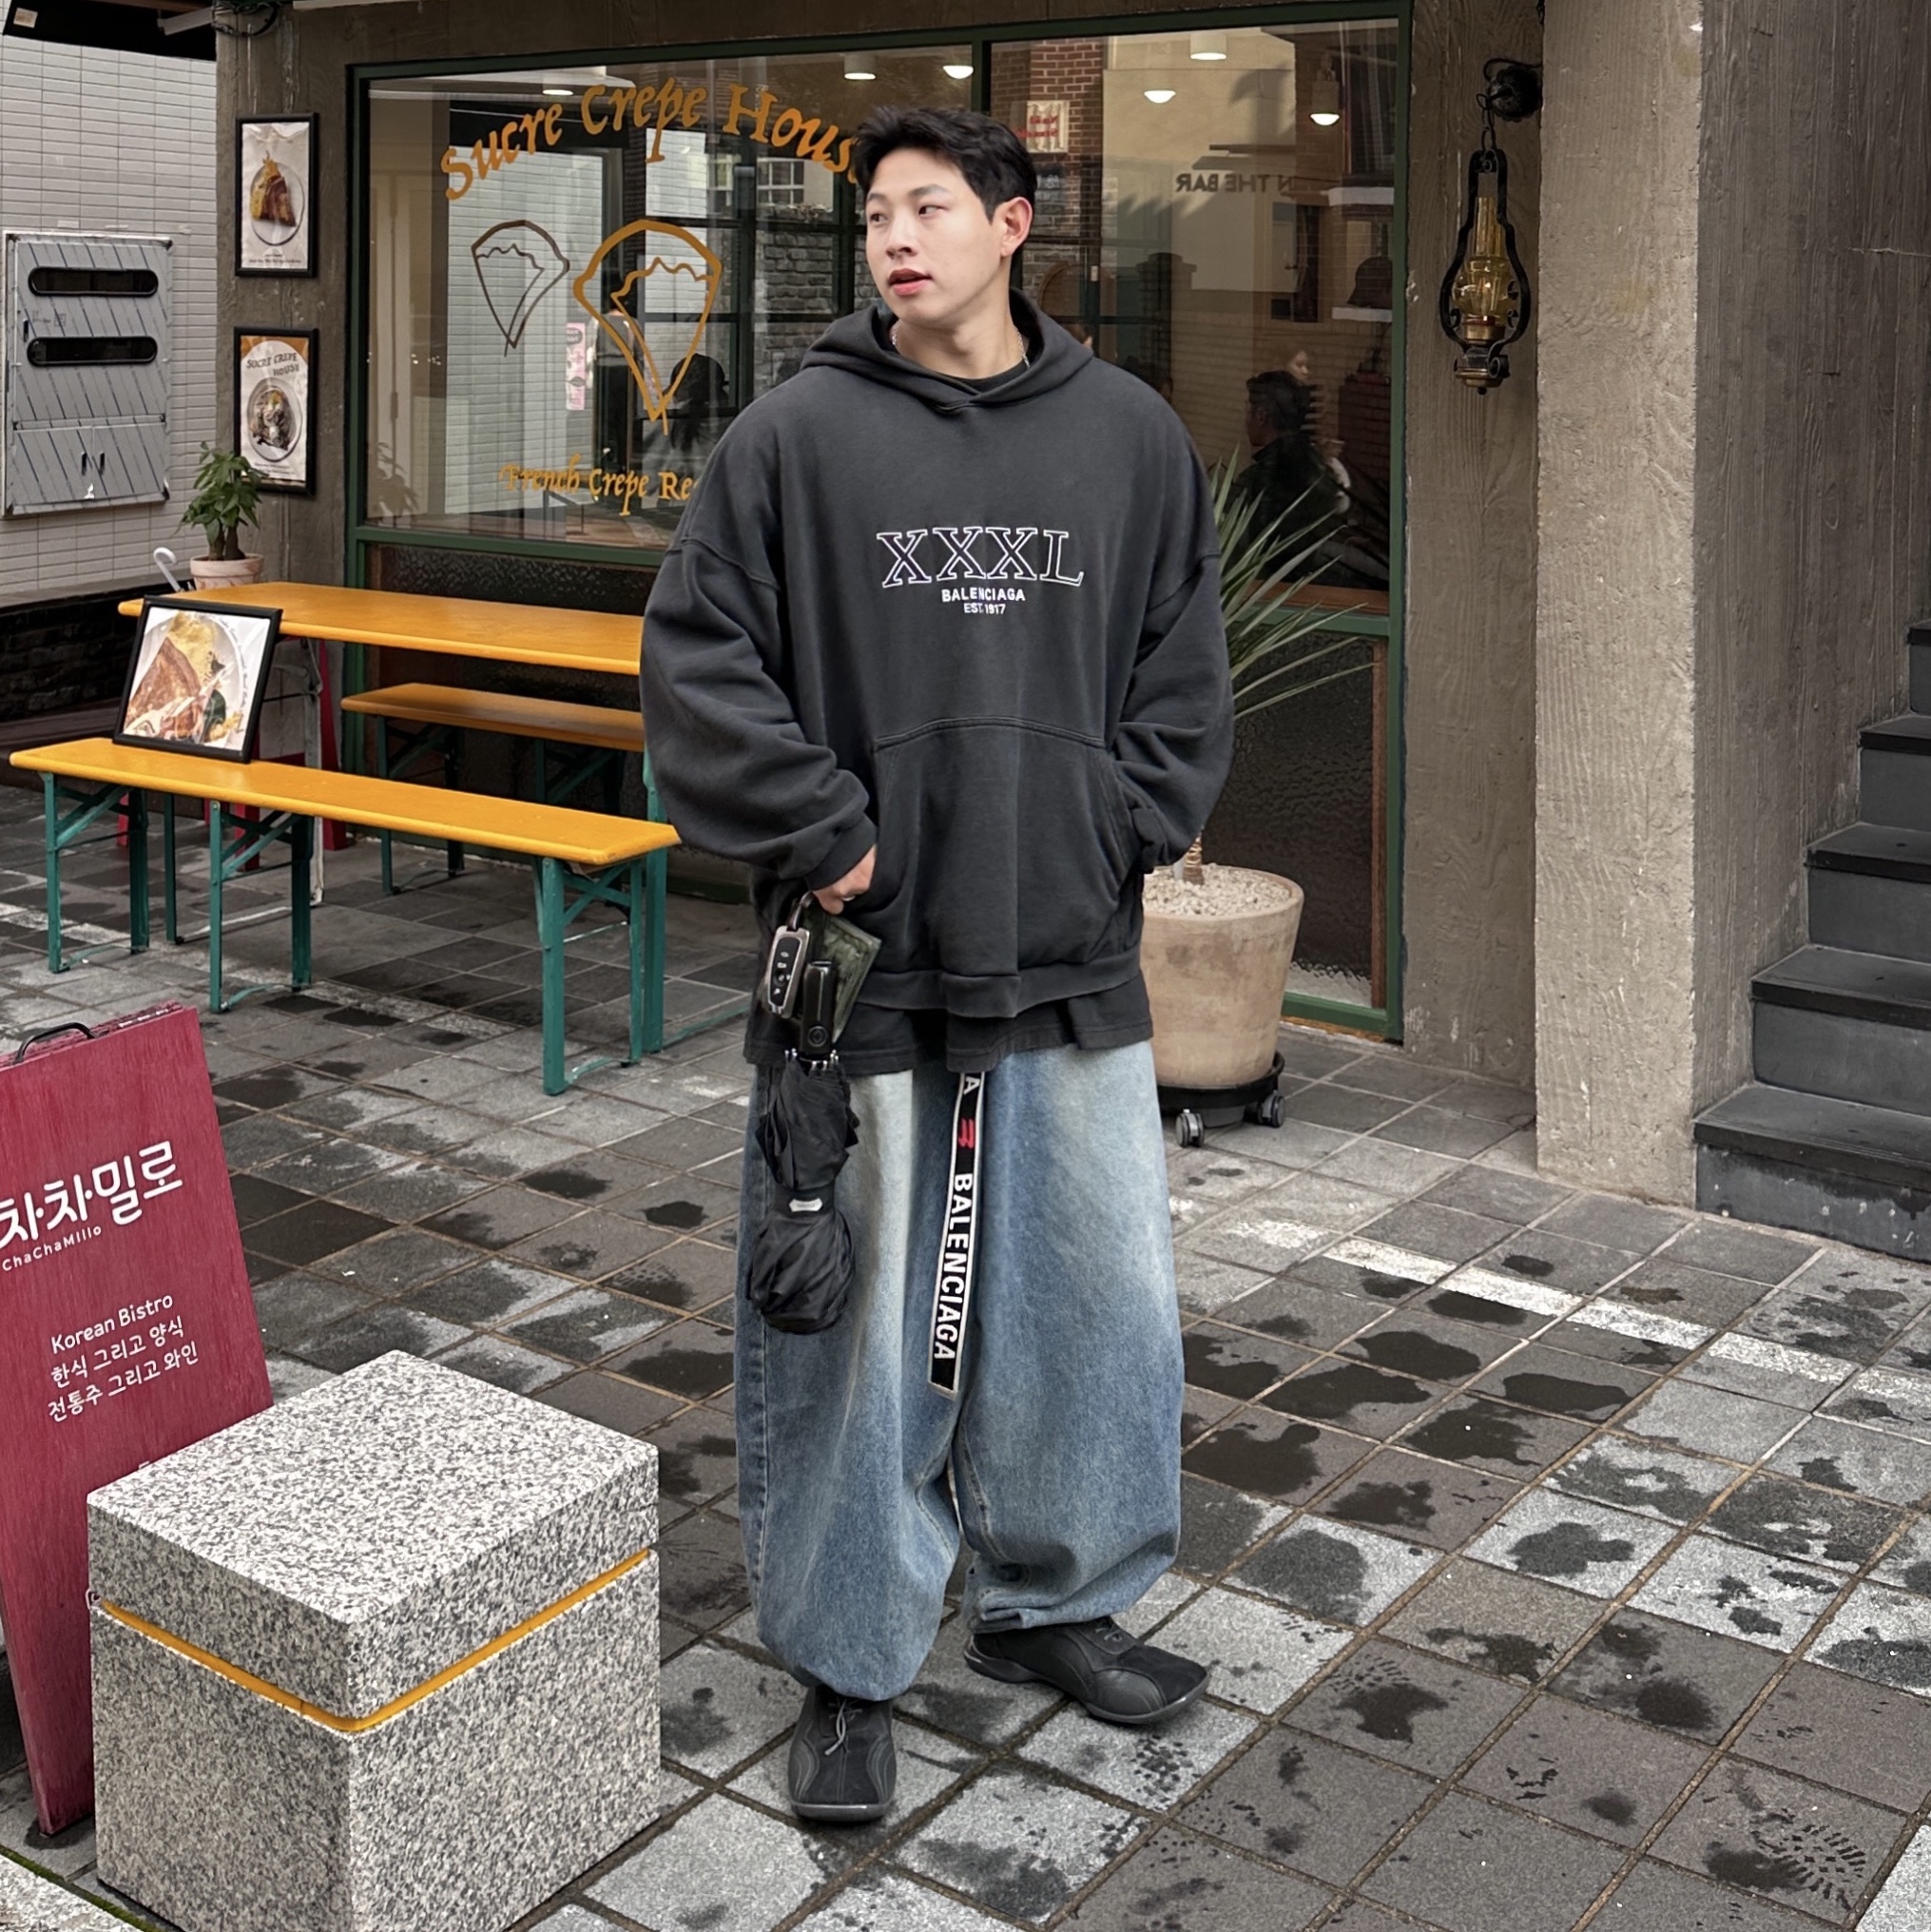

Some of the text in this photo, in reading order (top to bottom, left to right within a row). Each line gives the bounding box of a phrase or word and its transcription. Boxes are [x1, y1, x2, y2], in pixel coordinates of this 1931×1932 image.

[440, 77, 859, 201] Sucre Crepe Hous
[498, 453, 701, 516] French Crepe Re
[877, 527, 1084, 588] XXXL
[941, 587, 1026, 602] BALENCIAGA
[0, 1140, 183, 1249] 차차밀로
[934, 1172, 974, 1360] BALENCIAGA
[50, 1295, 173, 1354] Korean Bistro
[50, 1315, 184, 1389] 한식 그리고 양식
[48, 1341, 199, 1422] 전통주 그리고 와인
